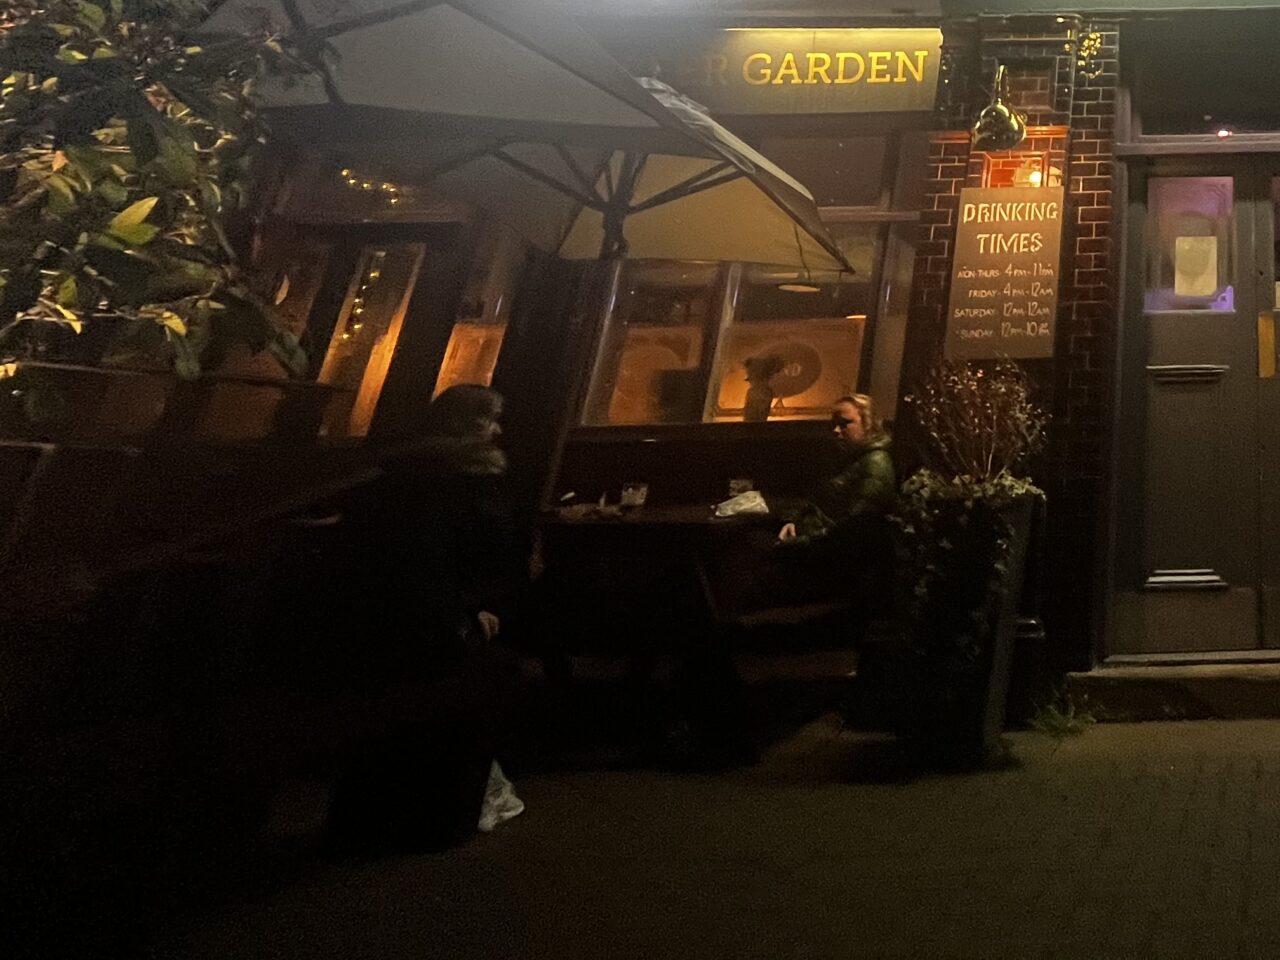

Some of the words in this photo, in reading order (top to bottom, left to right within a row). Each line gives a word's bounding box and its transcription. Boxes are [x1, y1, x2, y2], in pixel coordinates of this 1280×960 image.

[742, 50, 929, 86] GARDEN
[963, 202, 1059, 224] DRINKING
[976, 232, 1043, 254] TIMES
